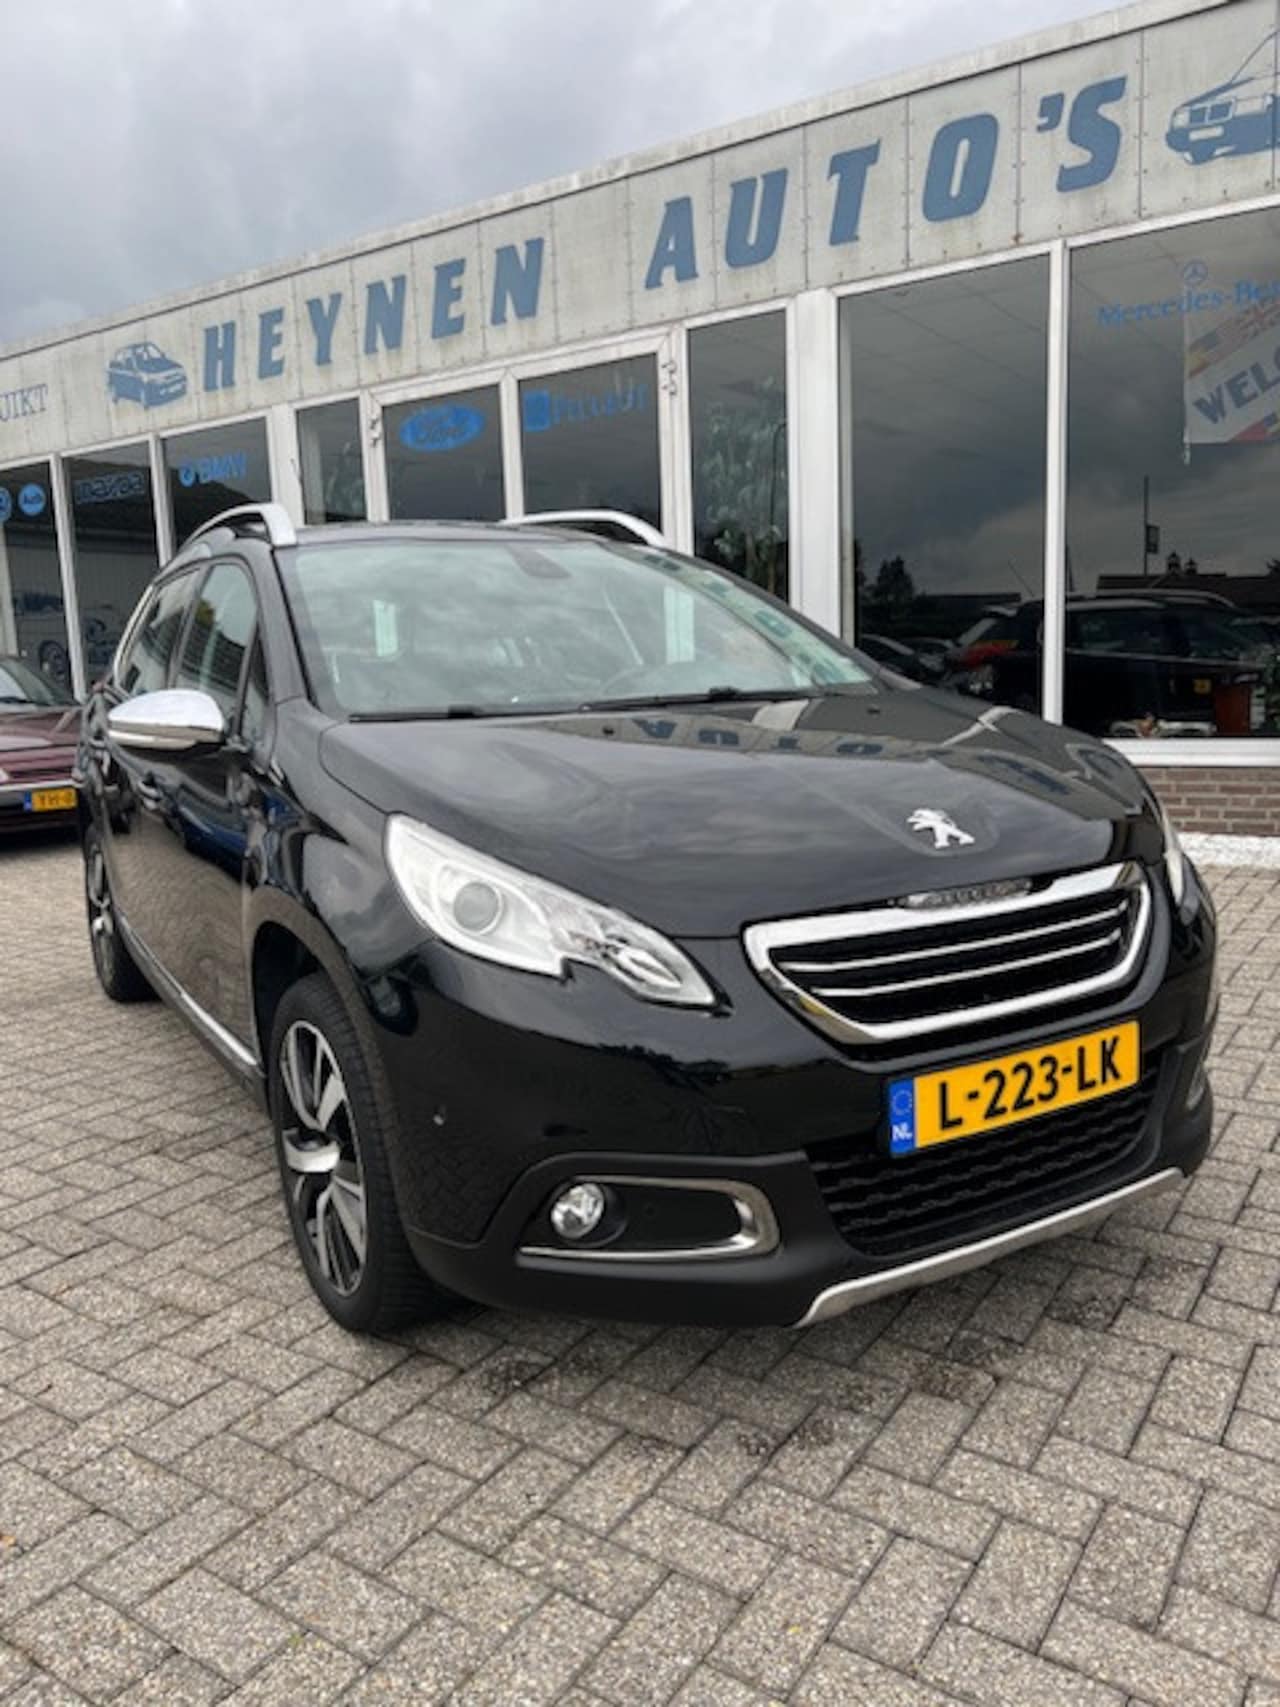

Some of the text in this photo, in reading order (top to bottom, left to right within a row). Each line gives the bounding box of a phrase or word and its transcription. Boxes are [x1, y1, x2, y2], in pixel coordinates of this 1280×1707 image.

[204, 75, 1127, 392] HEYNEN AUTO'S
[940, 1037, 1120, 1130] L-223-LK
[892, 1125, 912, 1142] NL
